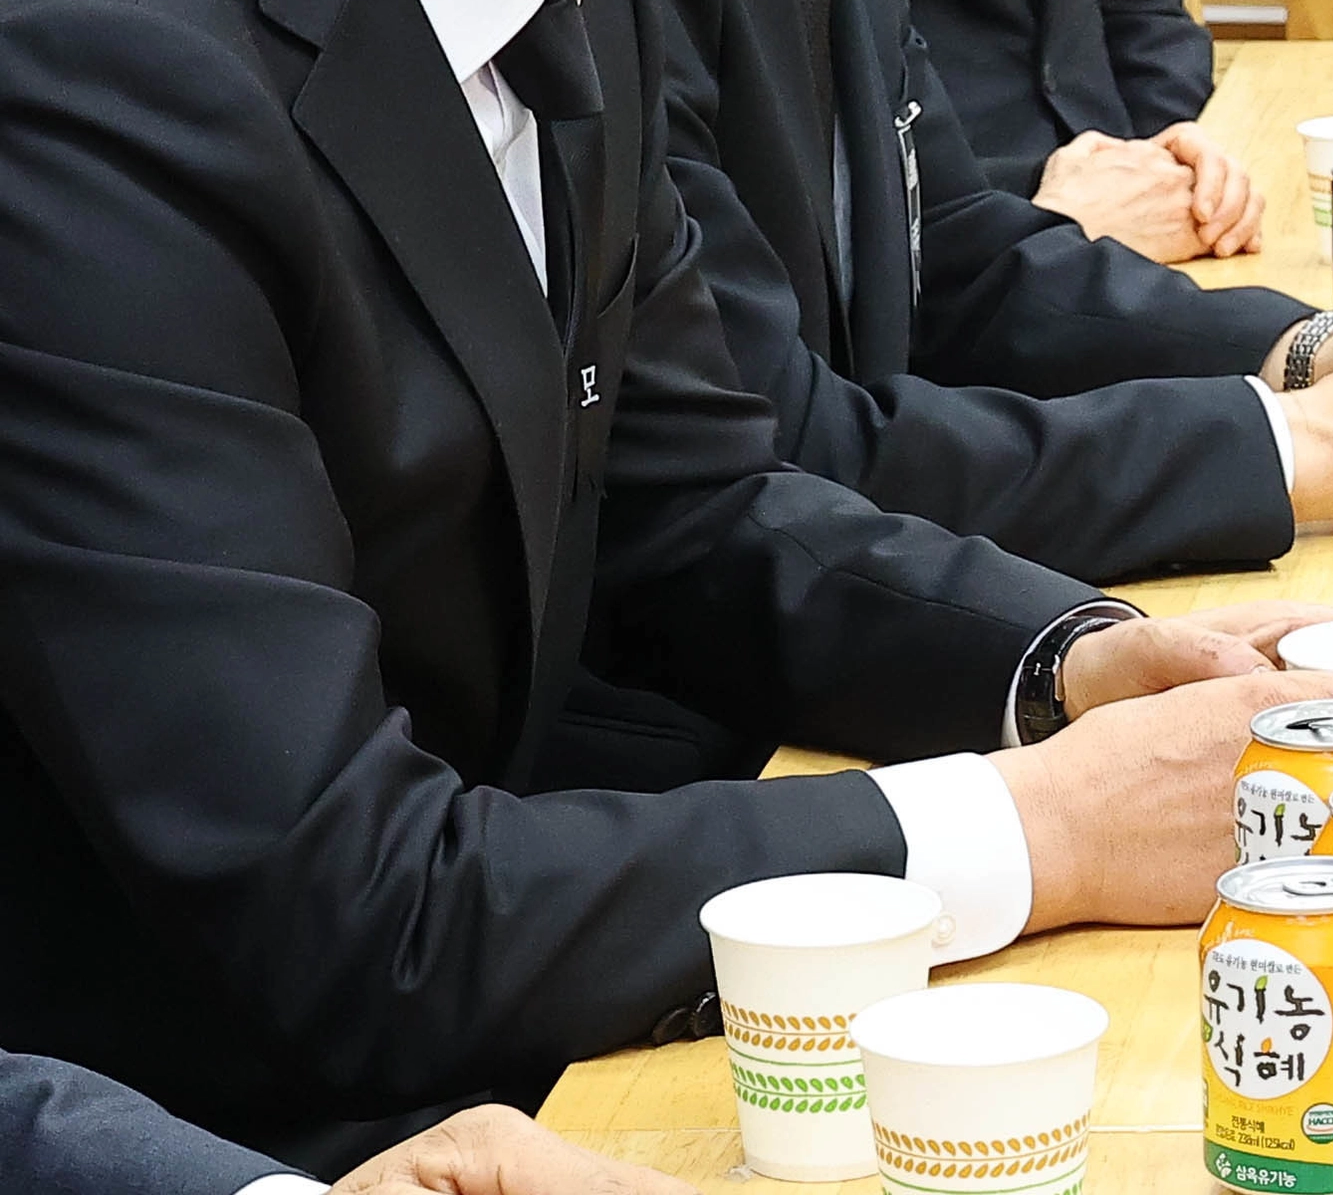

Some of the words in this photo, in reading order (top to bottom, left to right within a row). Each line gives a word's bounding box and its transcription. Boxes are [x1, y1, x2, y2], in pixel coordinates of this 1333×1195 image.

[1203, 968, 1326, 1041] 유기농
[1213, 1035, 1306, 1087] 식혜
[1235, 1164, 1297, 1188] 삼육유기농
